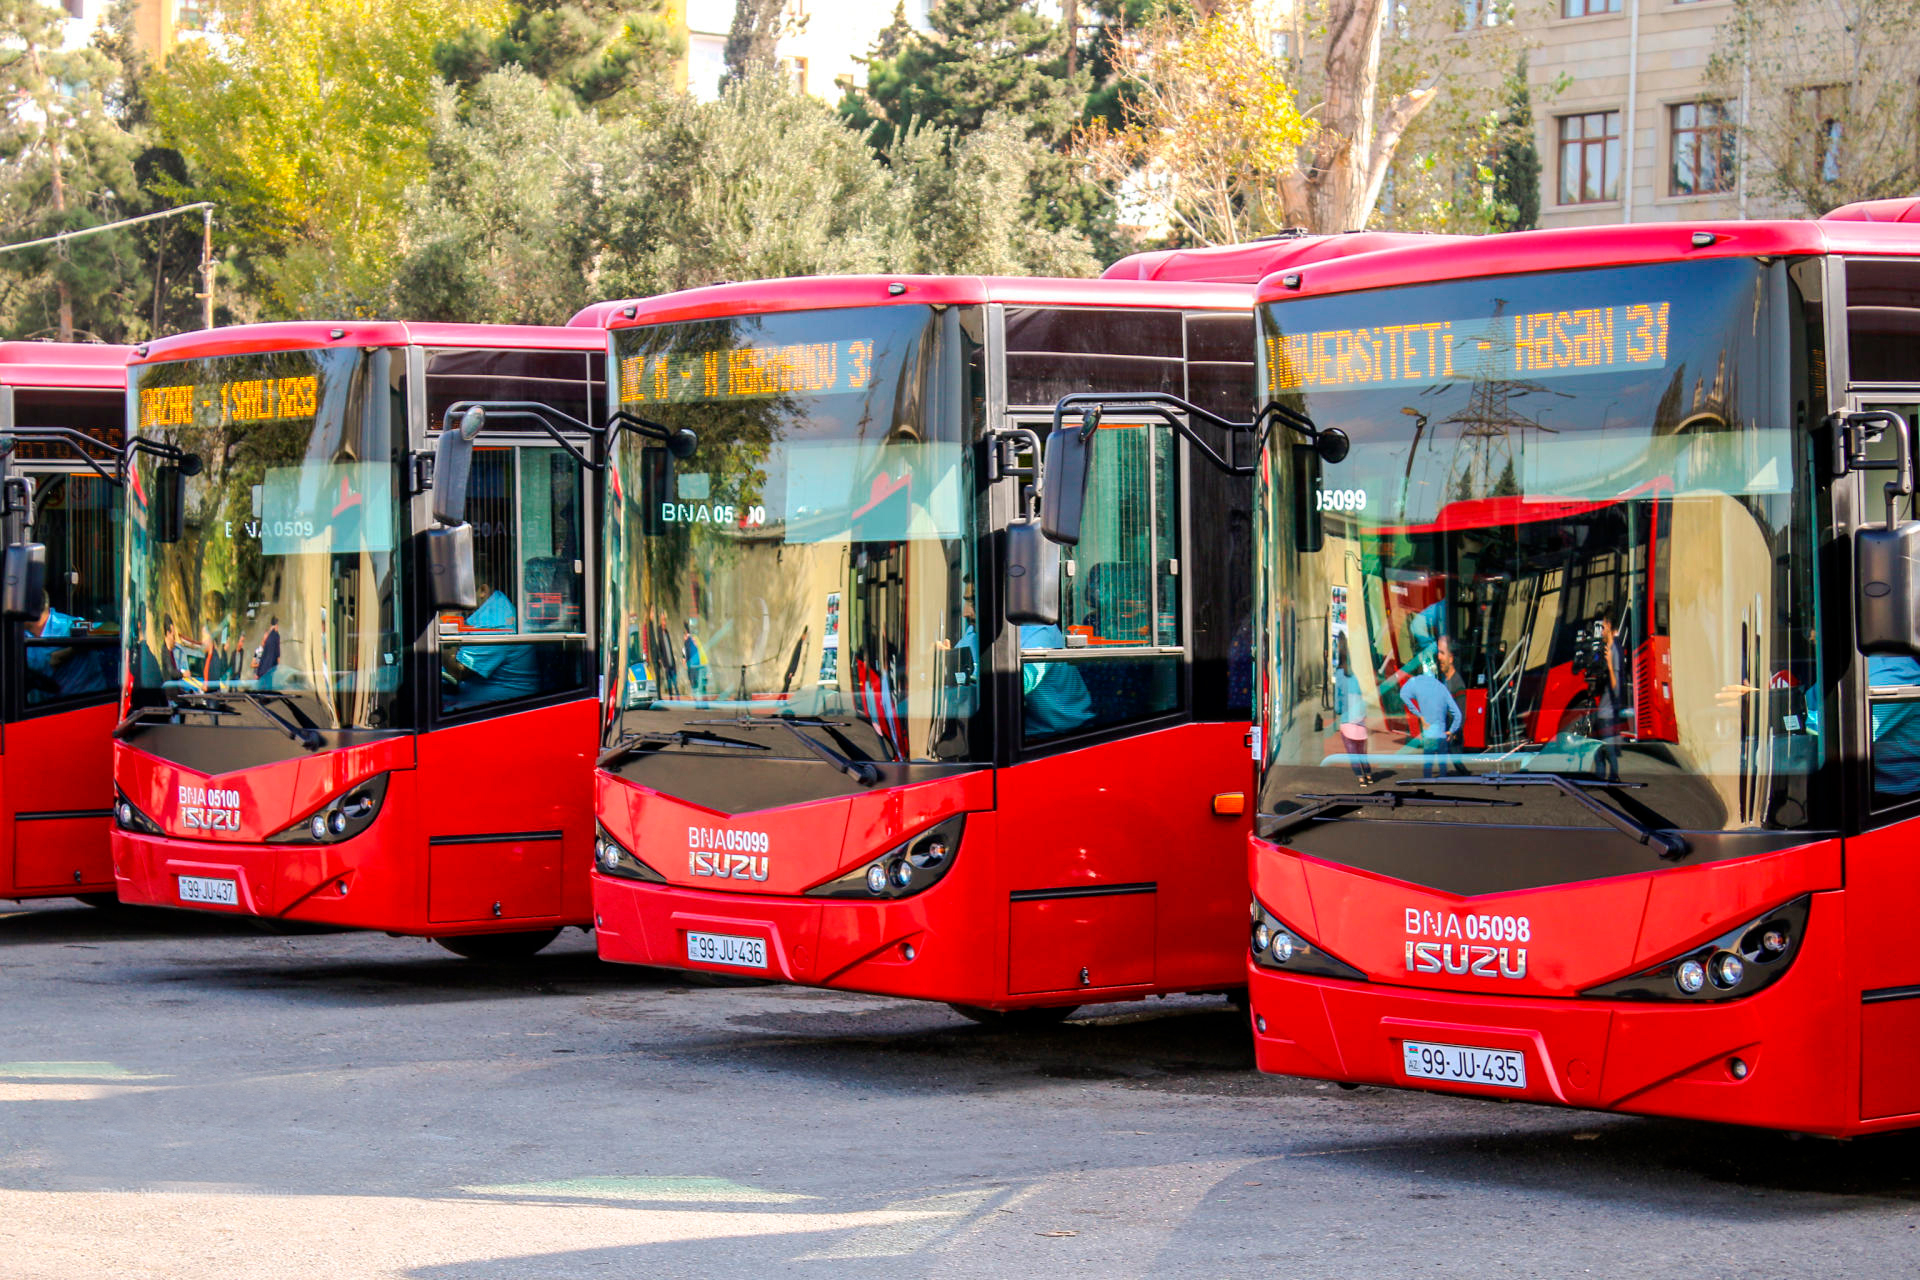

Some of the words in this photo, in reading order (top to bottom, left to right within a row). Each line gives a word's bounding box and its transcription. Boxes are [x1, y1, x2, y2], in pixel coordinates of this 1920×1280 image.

[181, 806, 241, 832] ISUZU
[688, 851, 769, 882] ISUZU
[1465, 914, 1531, 942] 05098
[1405, 941, 1527, 980] ISUZU
[1421, 1048, 1520, 1083] 99-JU-435
